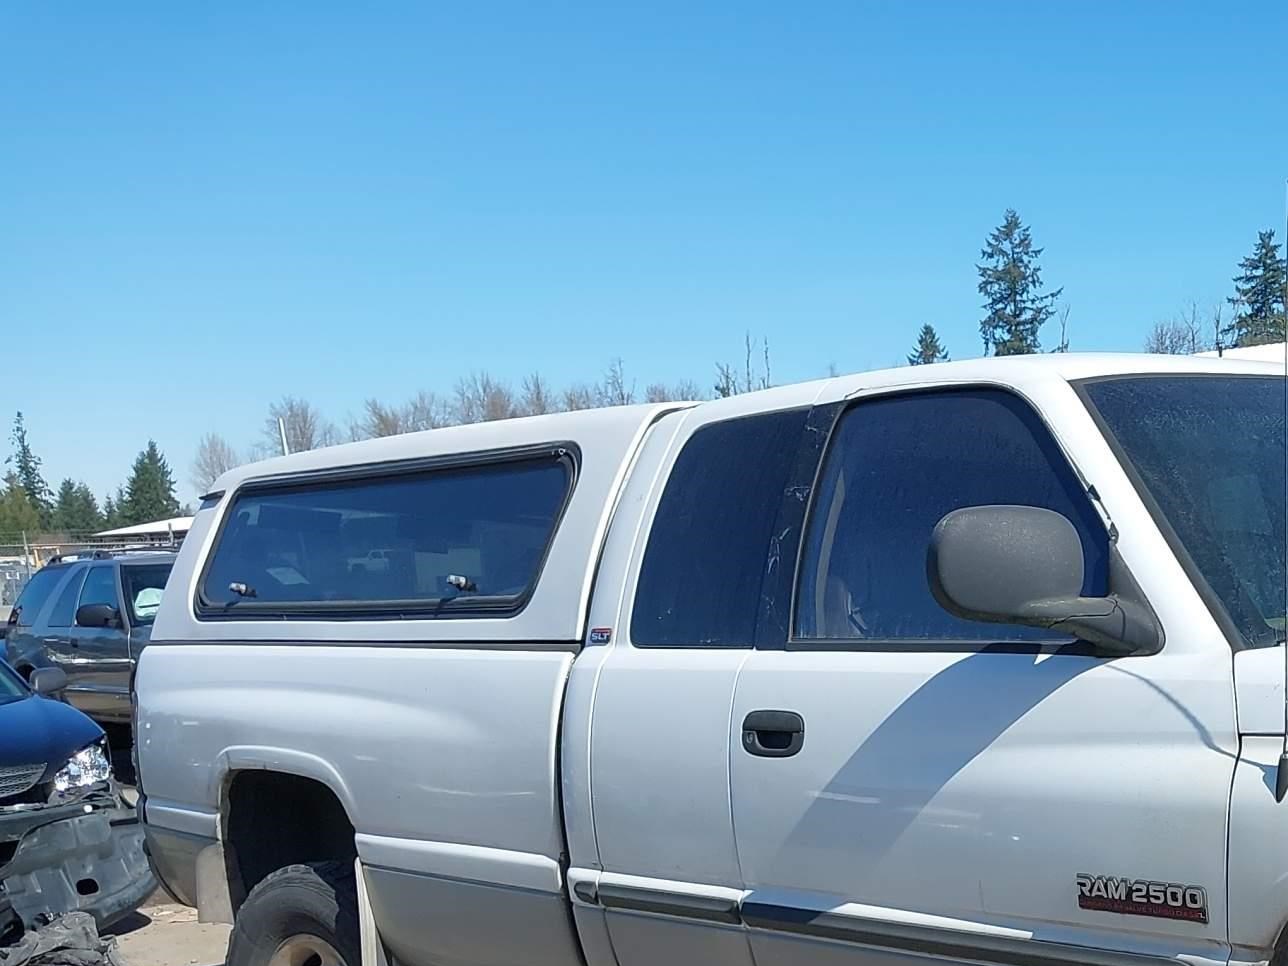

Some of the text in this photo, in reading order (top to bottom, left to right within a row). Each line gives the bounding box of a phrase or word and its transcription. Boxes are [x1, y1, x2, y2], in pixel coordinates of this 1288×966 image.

[592, 632, 610, 641] SLT
[1077, 875, 1127, 901] RAM
[1131, 880, 1205, 908] 2500
